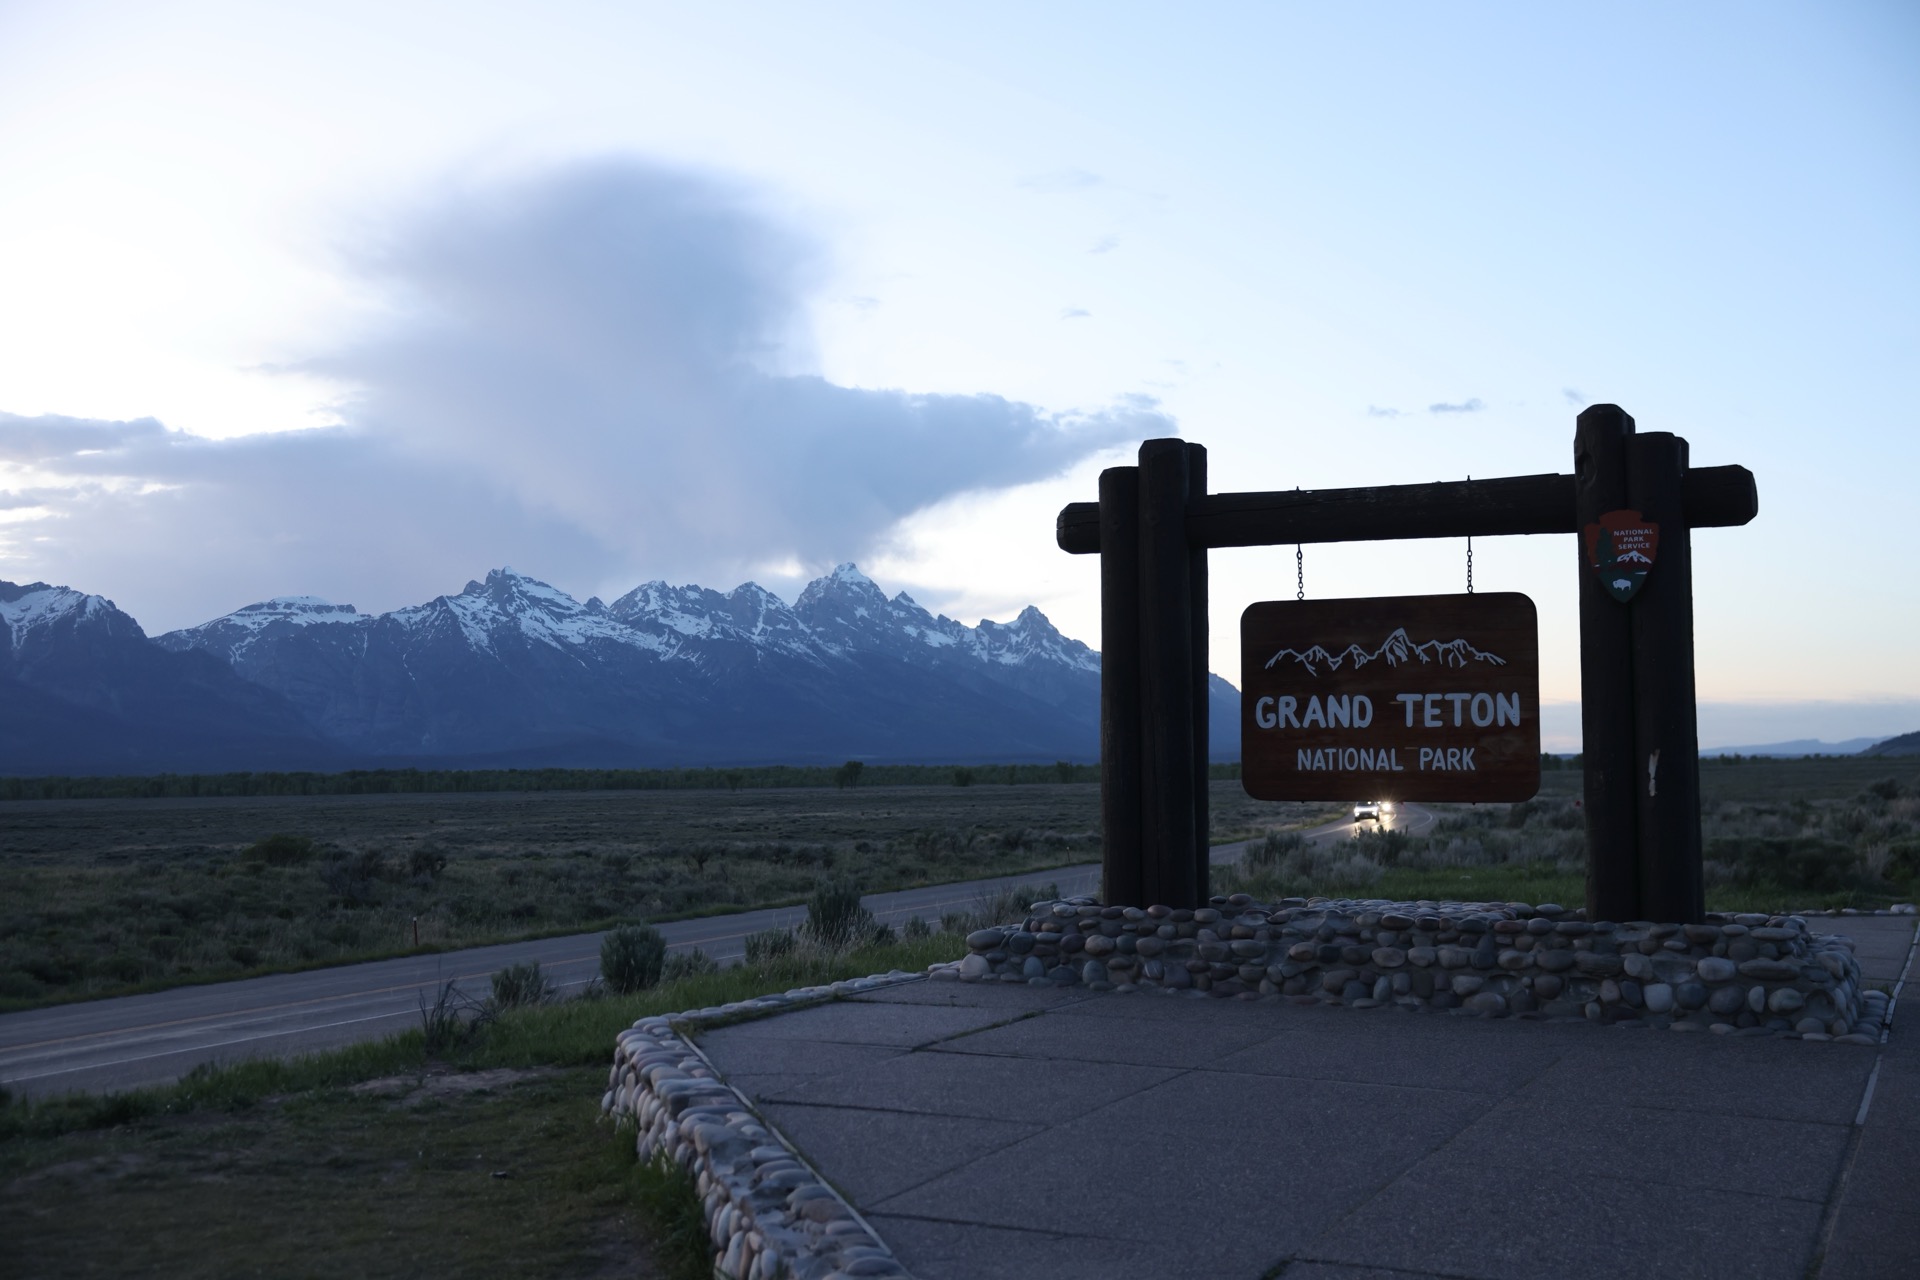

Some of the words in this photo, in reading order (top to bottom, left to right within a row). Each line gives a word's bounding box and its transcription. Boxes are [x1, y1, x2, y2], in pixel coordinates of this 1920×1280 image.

[1255, 693, 1374, 729] GRAND
[1396, 691, 1521, 728] TETON
[1297, 747, 1404, 772] NATIONAL
[1420, 747, 1476, 771] PARK
